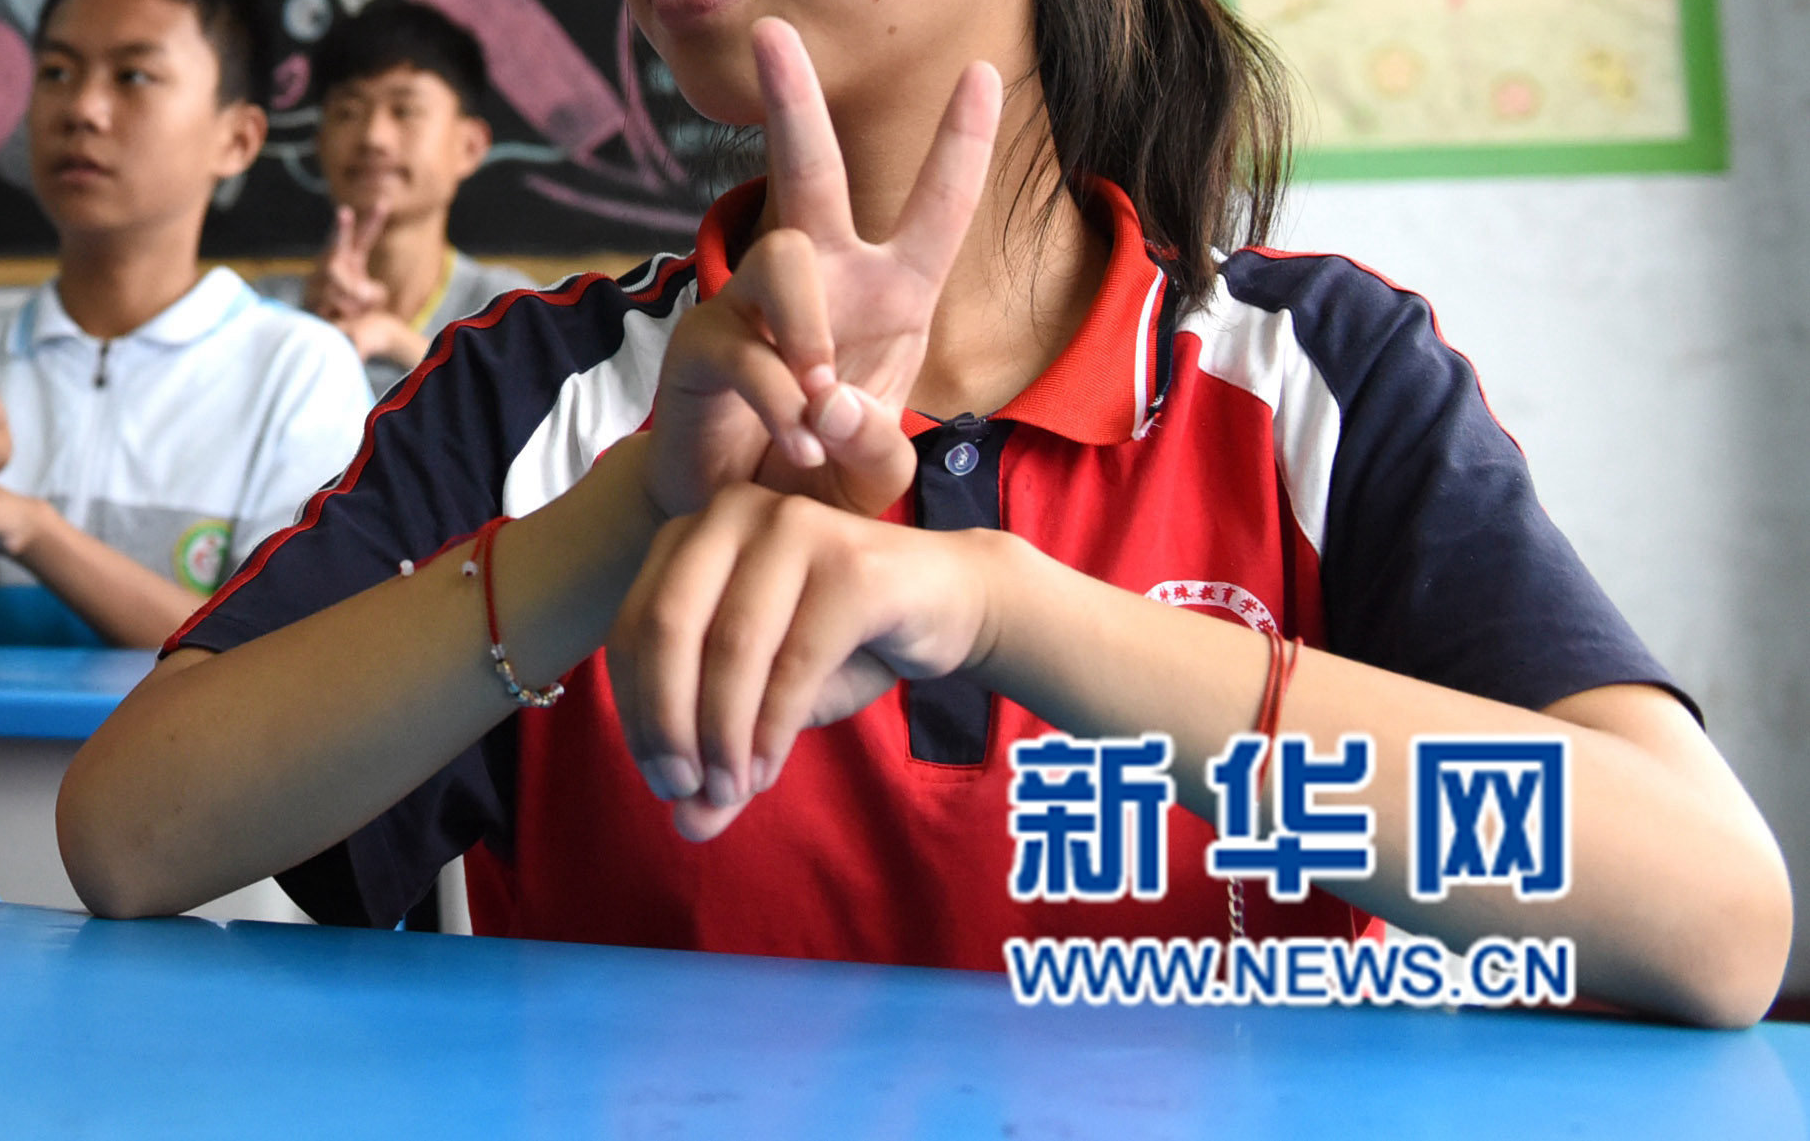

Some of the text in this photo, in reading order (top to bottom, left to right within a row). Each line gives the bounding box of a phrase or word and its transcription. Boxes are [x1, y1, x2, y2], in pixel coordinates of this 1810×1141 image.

[1157, 582, 1276, 634] 特殊教育学校
